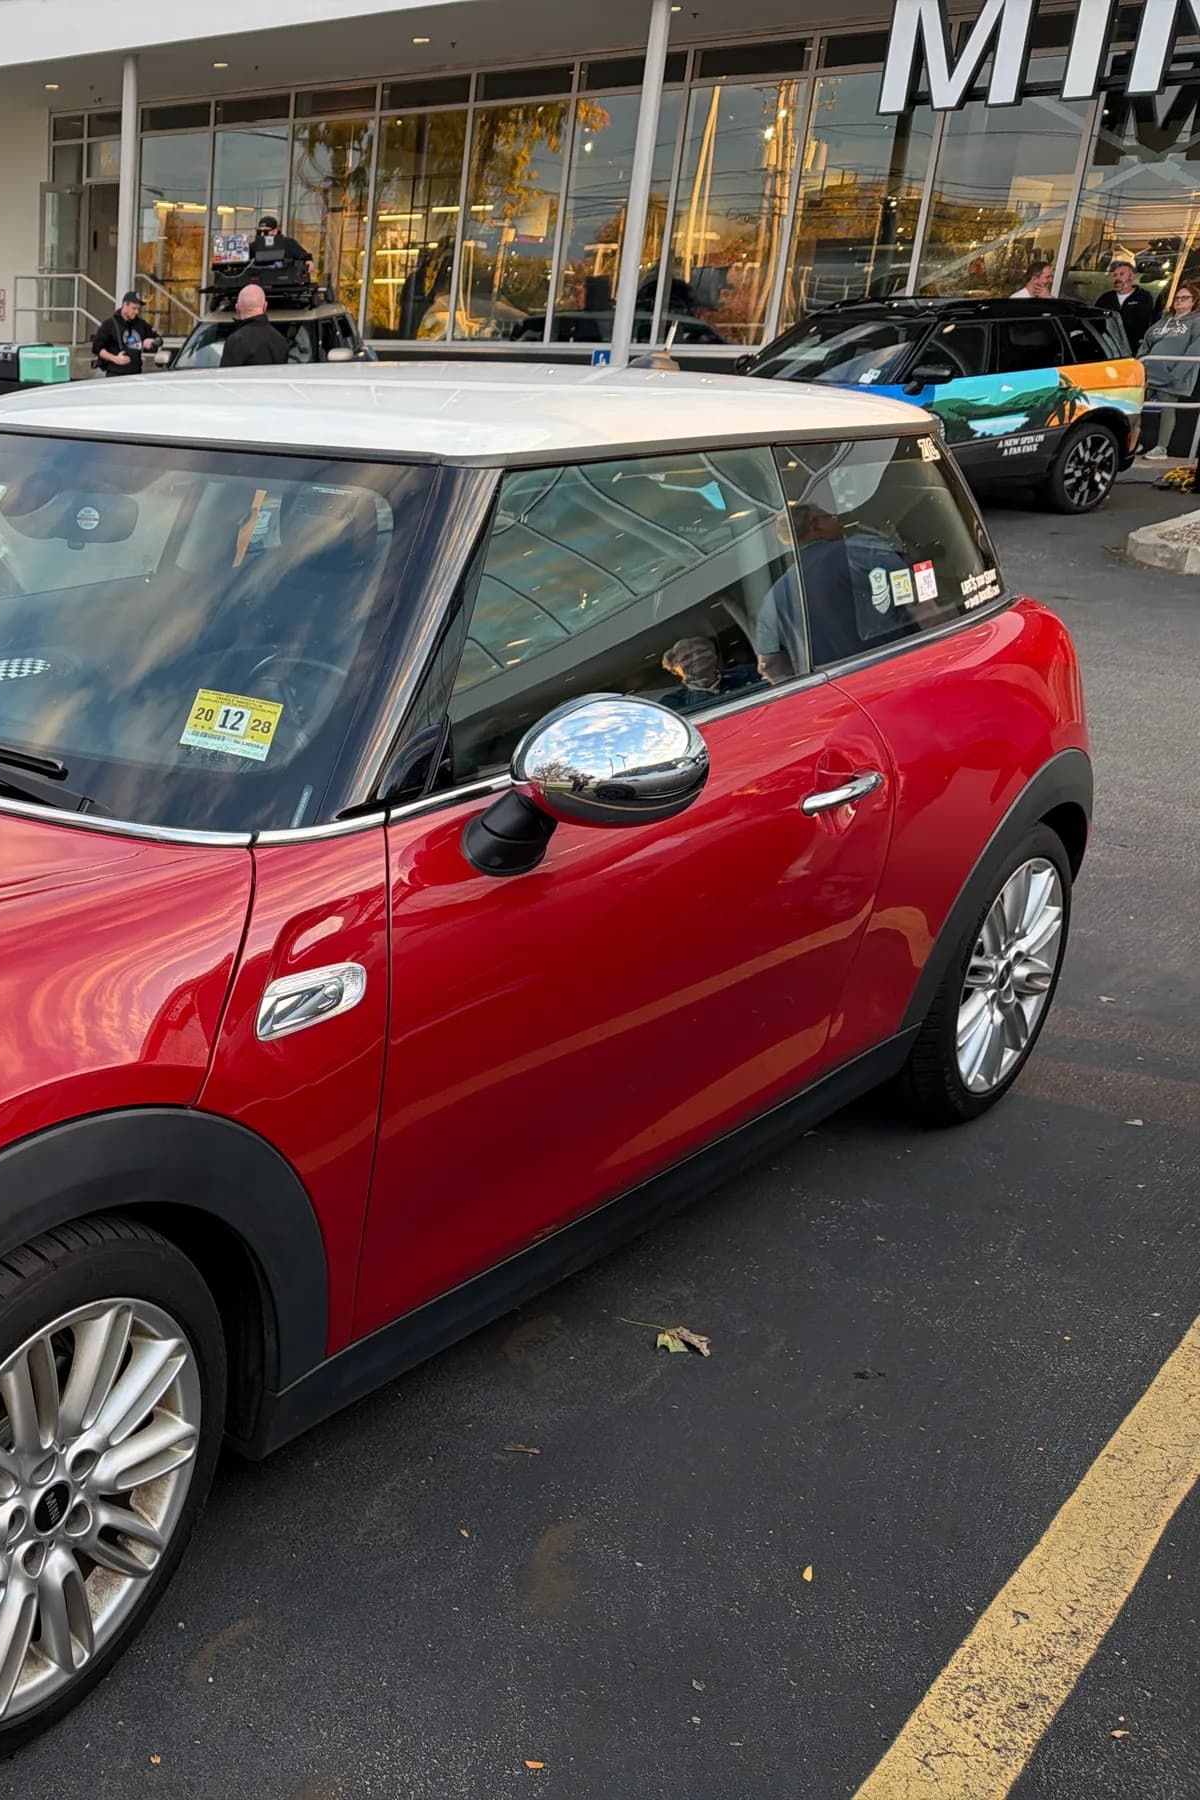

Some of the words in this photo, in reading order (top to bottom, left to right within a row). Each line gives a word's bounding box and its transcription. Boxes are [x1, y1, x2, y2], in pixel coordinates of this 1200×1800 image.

[195, 707, 214, 722] 20
[218, 709, 245, 731] 12
[250, 719, 272, 734] 28
[45, 1491, 60, 1524] MINI
